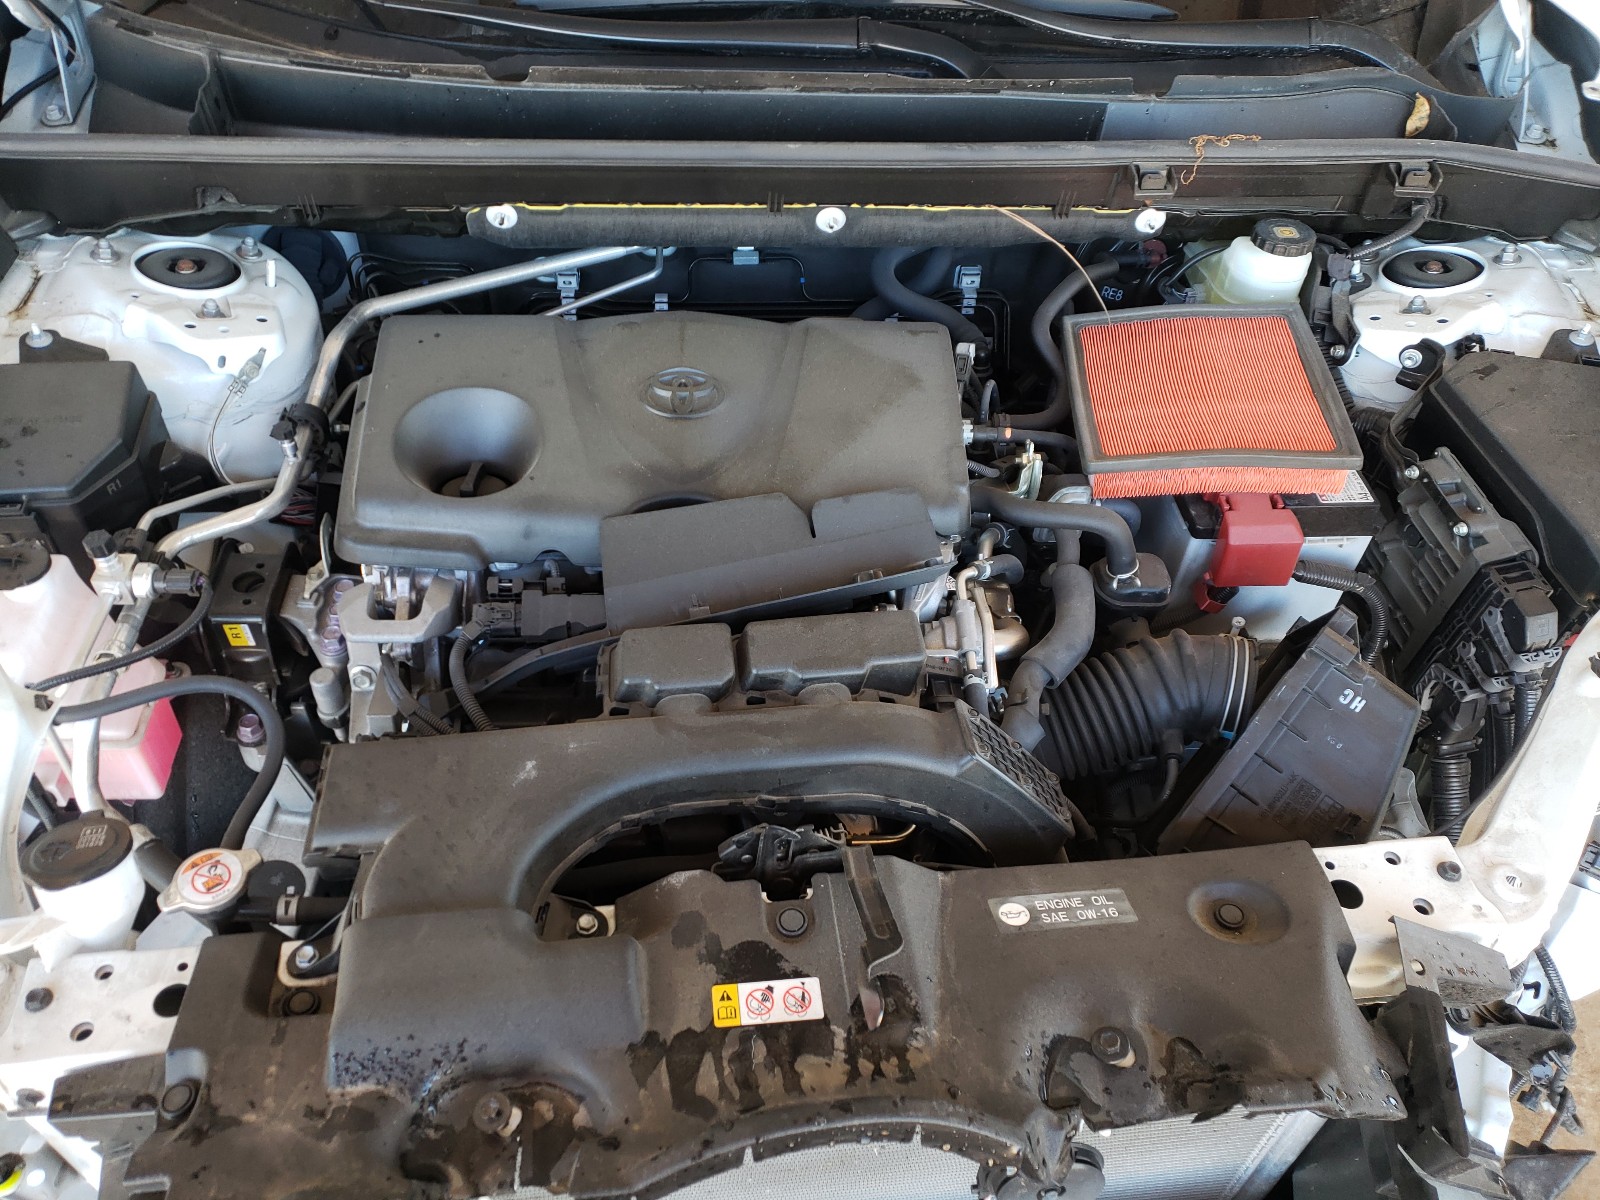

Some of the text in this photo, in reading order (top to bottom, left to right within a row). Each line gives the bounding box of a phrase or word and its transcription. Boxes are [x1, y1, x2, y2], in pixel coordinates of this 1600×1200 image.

[1101, 285, 1124, 301] RE8
[105, 479, 122, 495] R1
[228, 627, 242, 639] R1
[1338, 688, 1367, 713] HC
[1034, 895, 1114, 911] ENGINE OIL
[1041, 907, 1119, 923] SAE 0W-16
